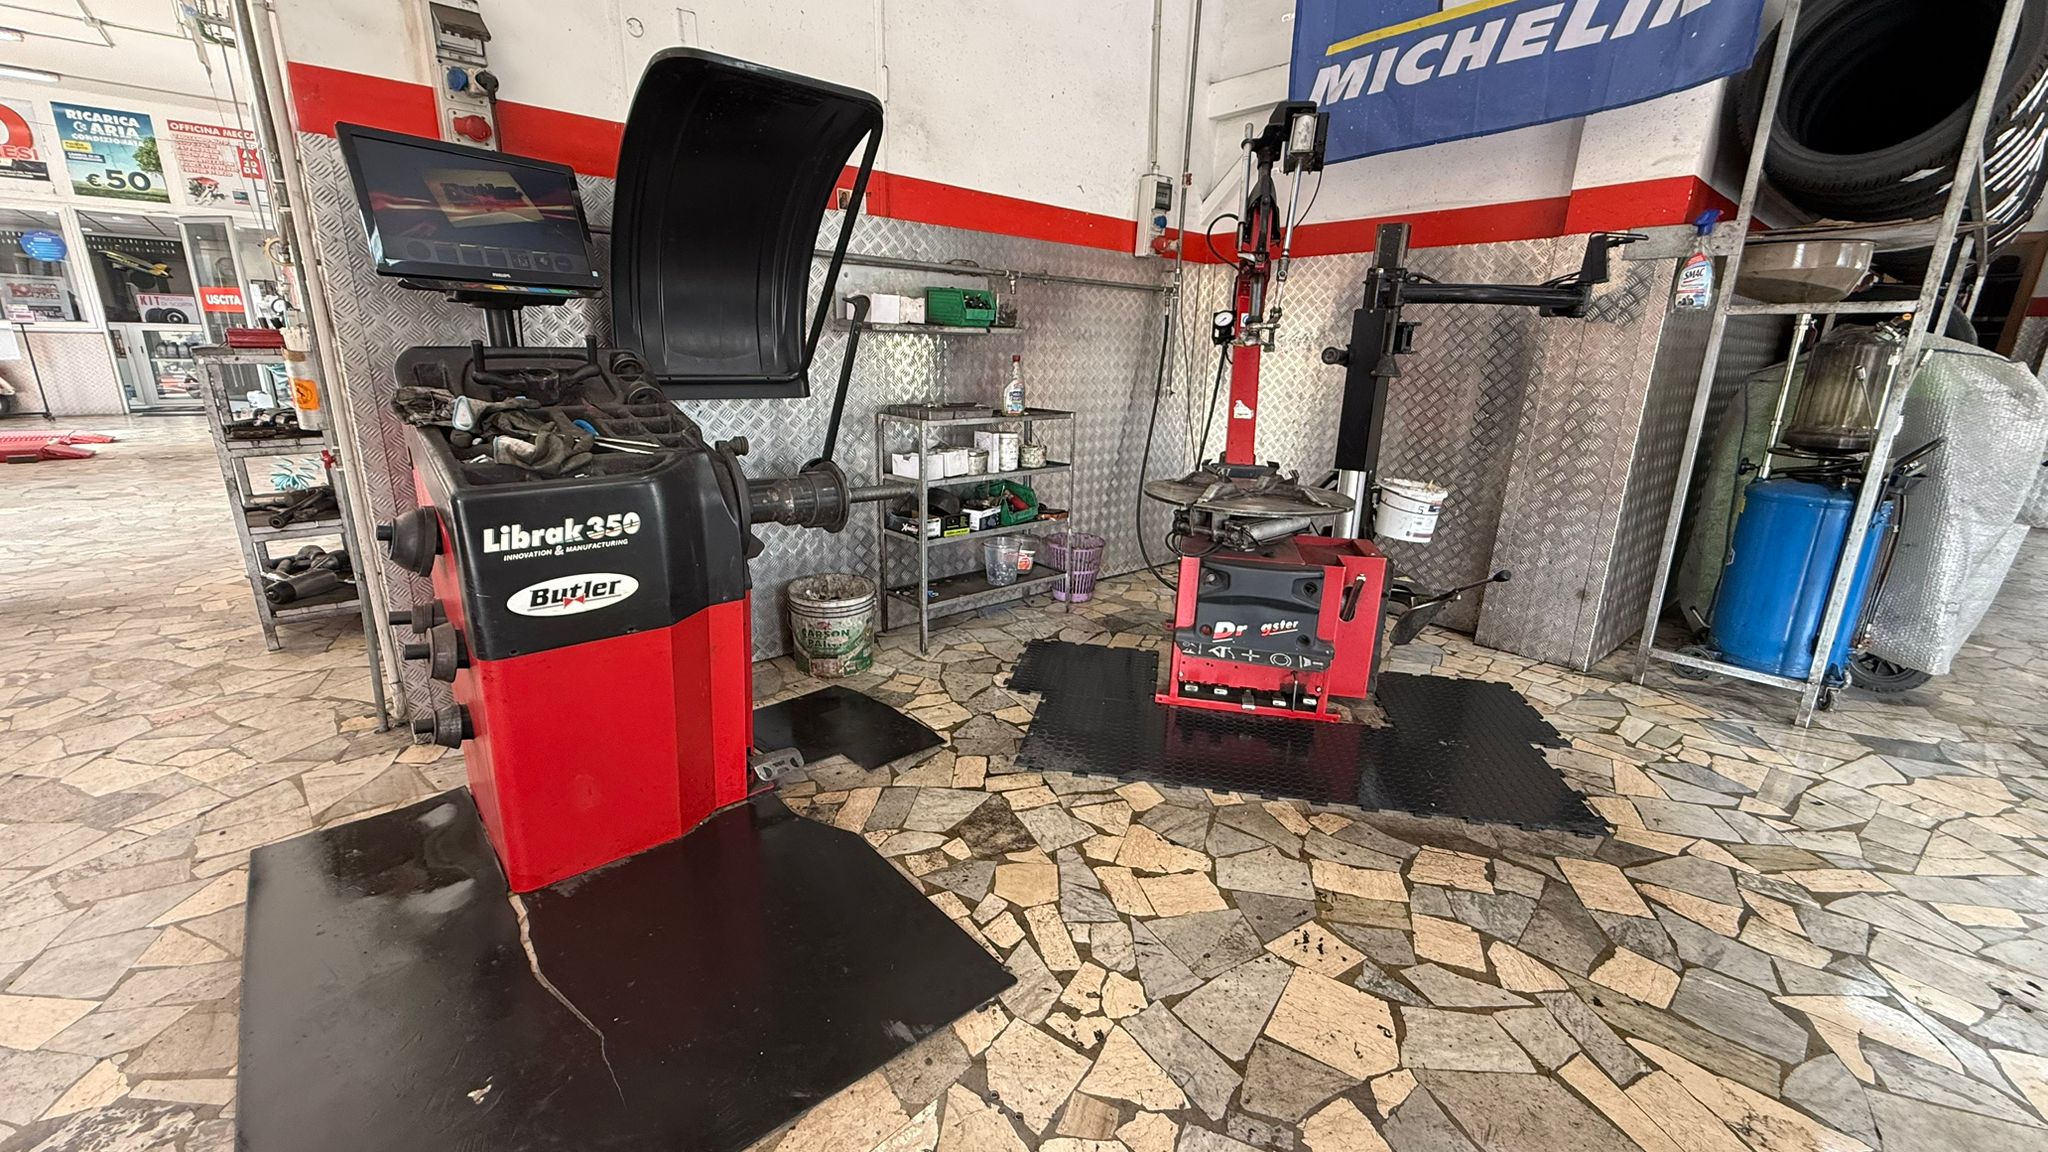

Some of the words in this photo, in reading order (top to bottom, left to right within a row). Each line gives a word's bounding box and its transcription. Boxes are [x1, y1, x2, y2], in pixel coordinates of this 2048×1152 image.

[65, 109, 140, 128] RICARICA
[90, 122, 142, 140] ARIA
[170, 121, 220, 136] OFFICINA
[0, 145, 39, 161] ESI
[105, 169, 151, 191] 50
[1684, 268, 1705, 279] SMAC
[140, 296, 160, 305] KIT
[206, 294, 242, 305] USCITA
[484, 518, 585, 553] Librak
[586, 511, 640, 539] 350
[503, 548, 553, 561] INNOVATION
[554, 545, 565, 556] &
[565, 539, 629, 552] MANUFACTURING
[529, 580, 622, 608] Butler
